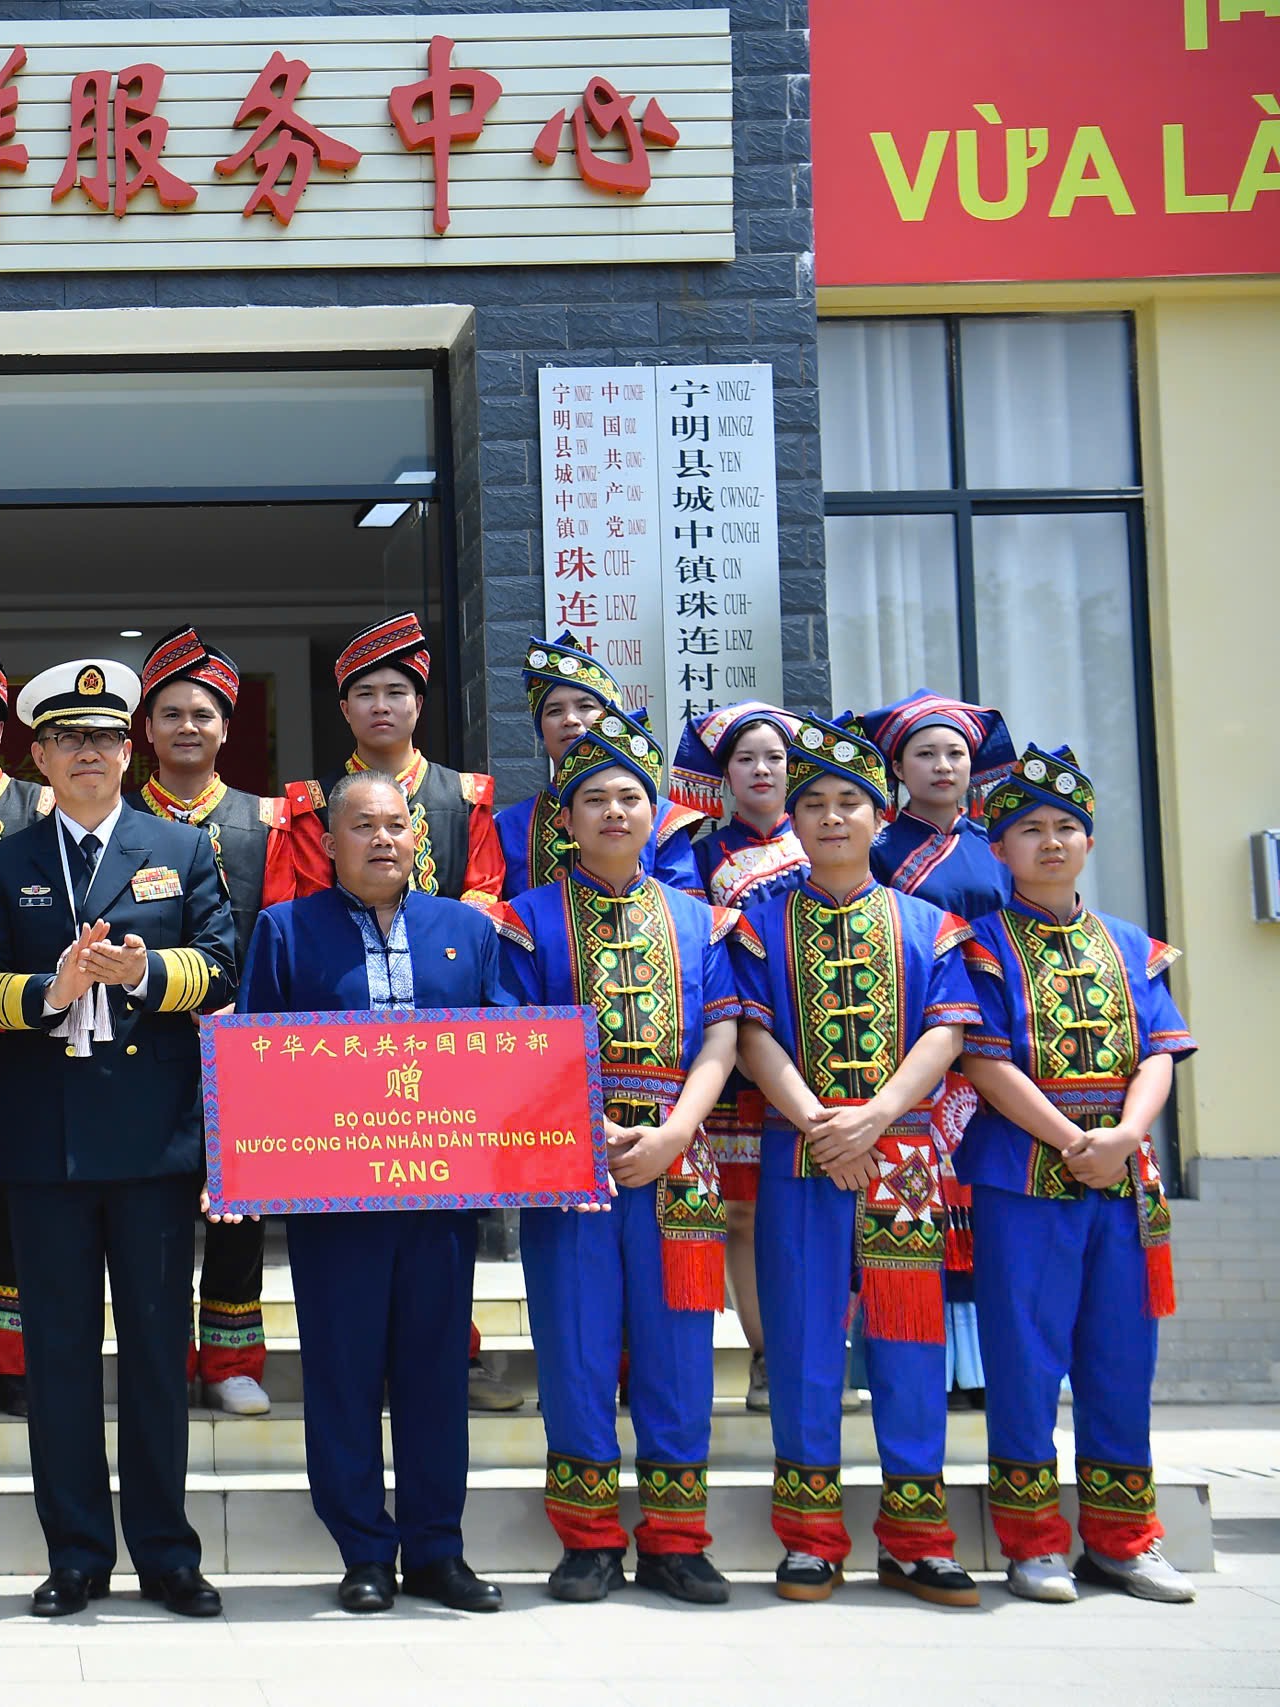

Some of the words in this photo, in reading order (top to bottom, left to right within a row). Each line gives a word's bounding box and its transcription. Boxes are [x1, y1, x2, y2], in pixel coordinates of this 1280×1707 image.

[872, 104, 1135, 221] VỪA
[716, 380, 756, 401] NINGZ-
[718, 416, 754, 437] MINGZ
[552, 383, 575, 538] 宁明县城中镇
[601, 382, 624, 538] 中国共产党
[719, 451, 741, 472] YEN
[720, 487, 765, 508] CWNGZ-
[721, 522, 760, 544] CUNGH
[604, 550, 636, 576] CUH-
[723, 558, 741, 579] CIN
[606, 595, 638, 622] LENZ
[724, 594, 752, 615] CUH-
[725, 629, 754, 651] LENZ
[607, 639, 643, 666] CUNH
[726, 666, 757, 688] CUNH
[251, 1030, 549, 1063] 中华人民共和国国防部
[385, 1059, 423, 1102] 赠
[335, 1112, 358, 1130] BỘ
[417, 1107, 477, 1124] PHÒNG
[235, 1136, 287, 1153] NƯỚC
[292, 1136, 341, 1155] CỘNG
[346, 1133, 382, 1150] HÒA
[385, 1131, 433, 1149] NHÂN
[438, 1131, 473, 1148] DÂN
[477, 1131, 535, 1147] TRUNG
[540, 1131, 576, 1145] HOA
